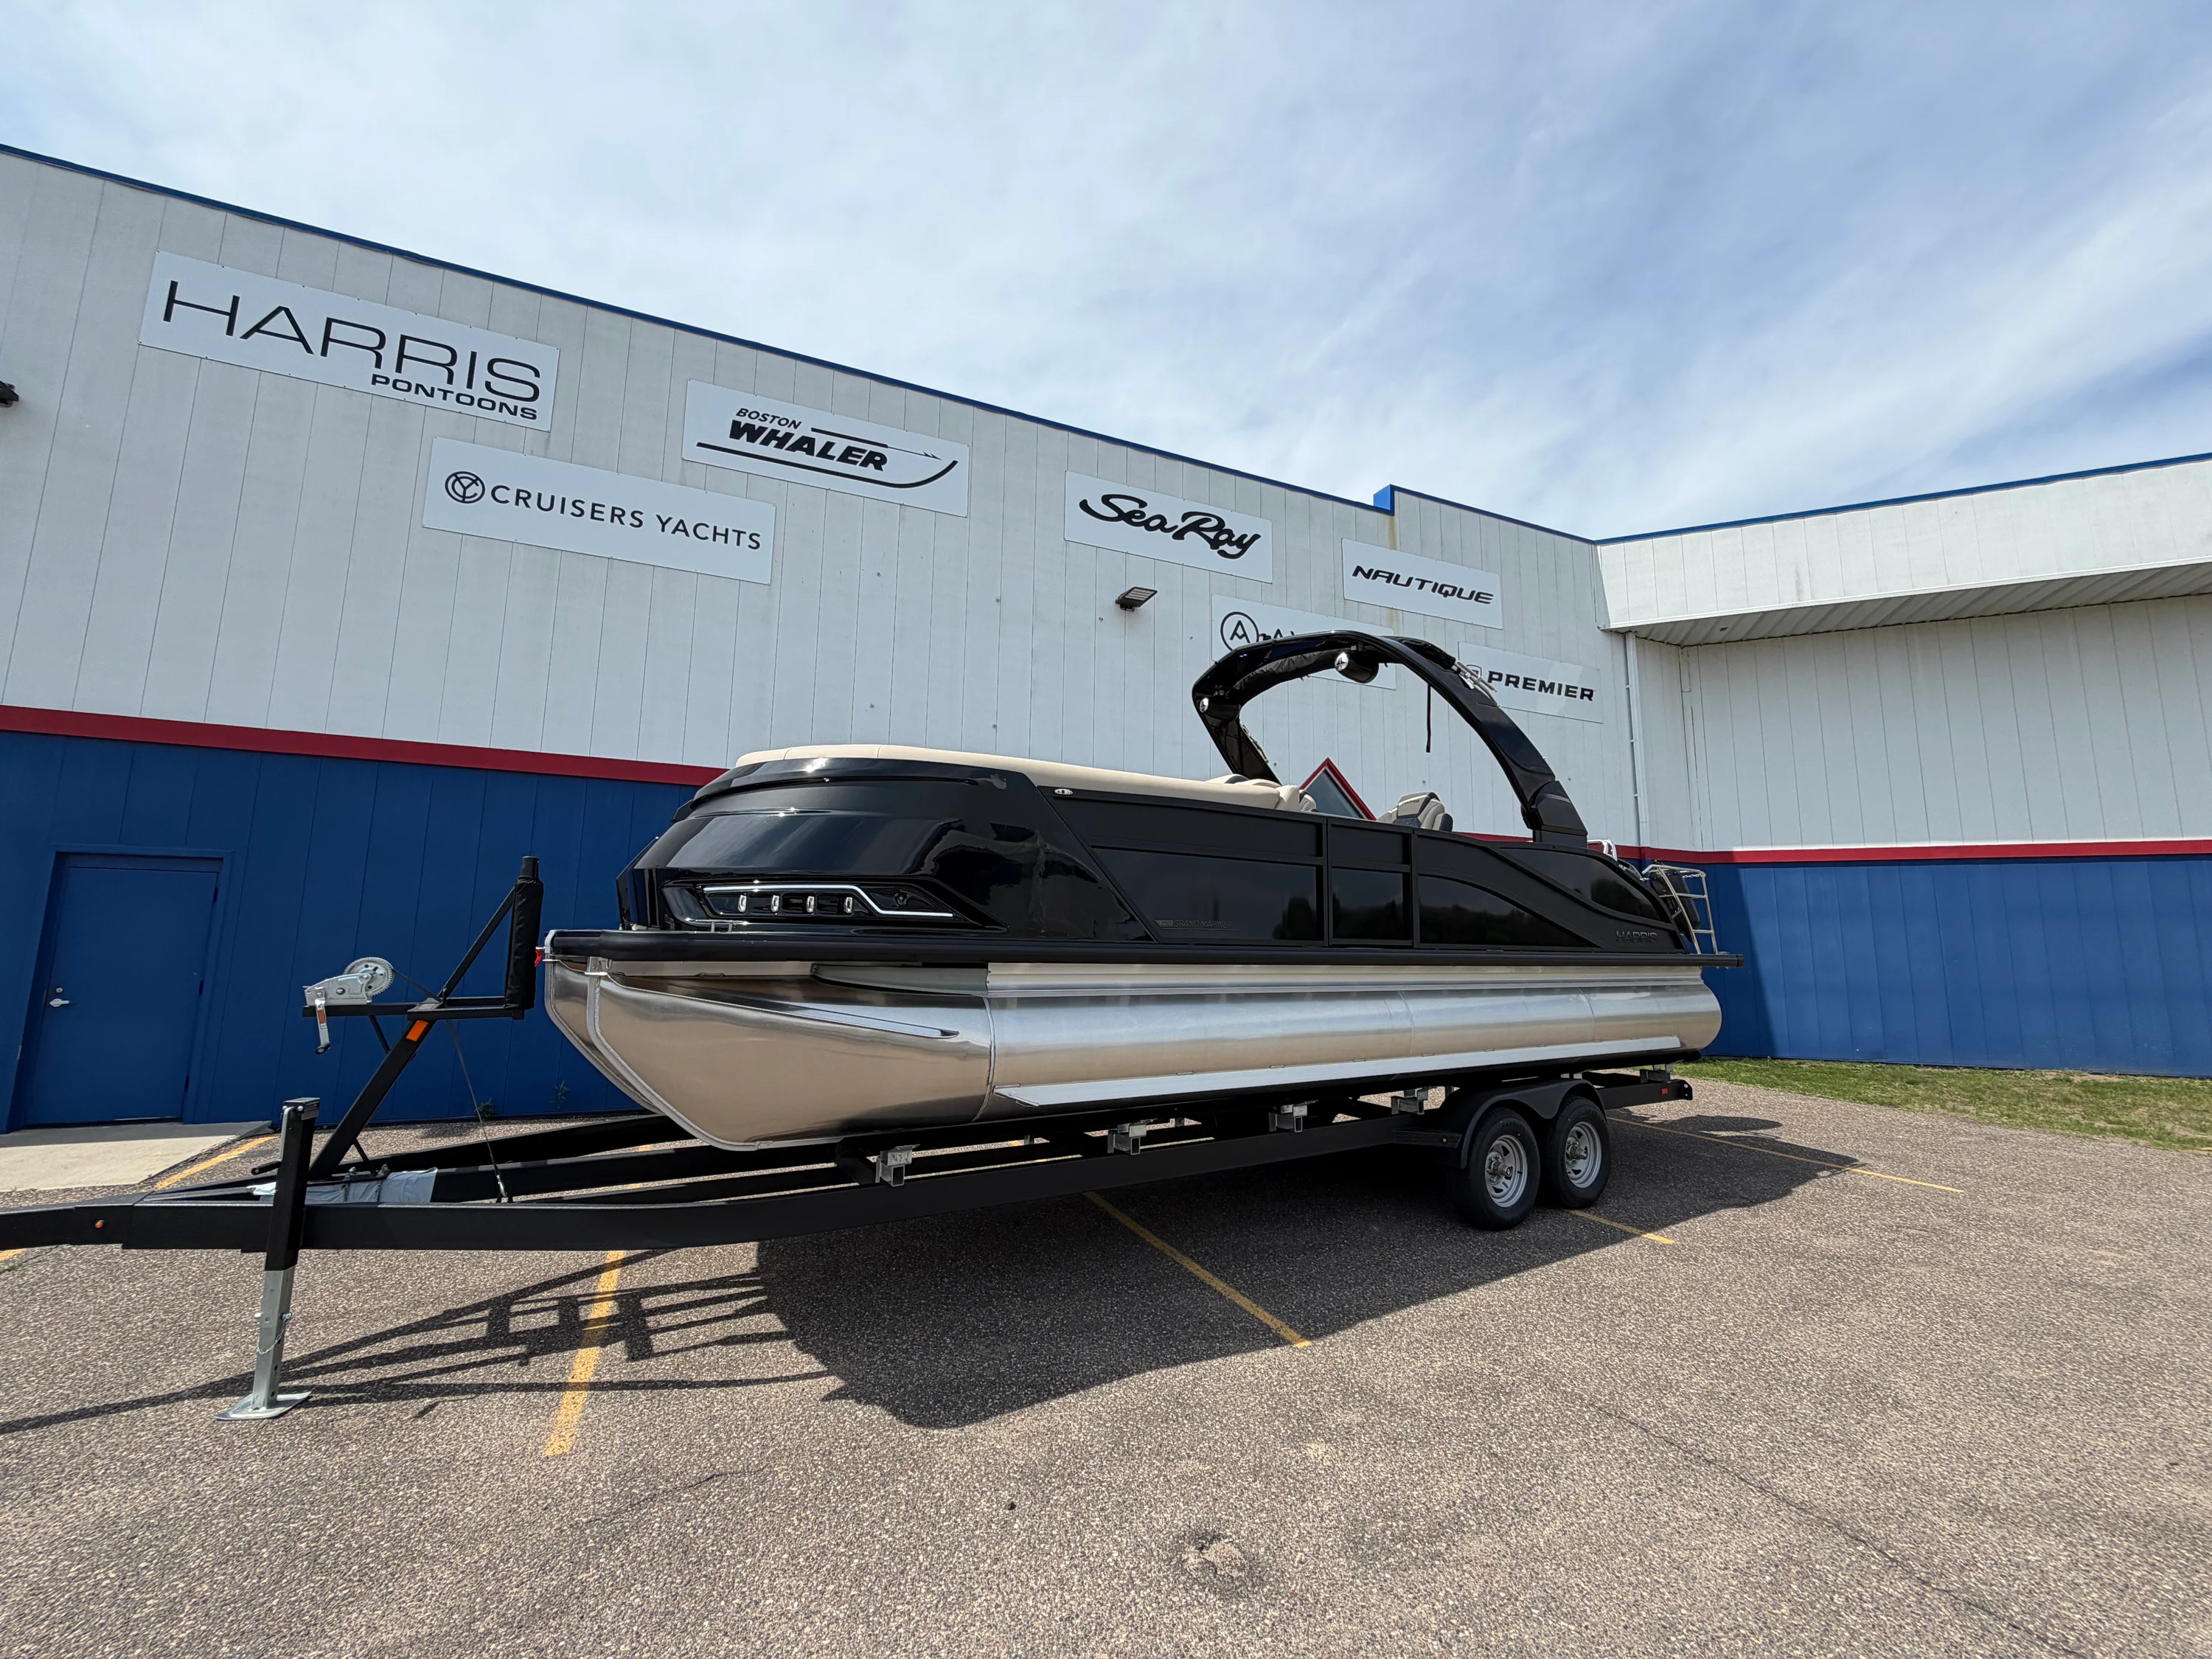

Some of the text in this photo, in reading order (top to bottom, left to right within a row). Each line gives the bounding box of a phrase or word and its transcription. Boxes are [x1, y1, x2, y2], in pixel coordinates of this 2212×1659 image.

[162, 279, 540, 403] HARRIS
[371, 373, 538, 420] PONTOONS
[735, 408, 802, 430] BOSTON
[728, 419, 888, 472] WHALER
[490, 484, 762, 550] CRUISERS YACHTS
[1079, 493, 1262, 560] Sea Ray
[1352, 565, 1494, 605] NAUTIQUE
[1487, 670, 1595, 702] PREMIER
[1173, 919, 1199, 928] GRAND
[1200, 920, 1232, 928] MARINER
